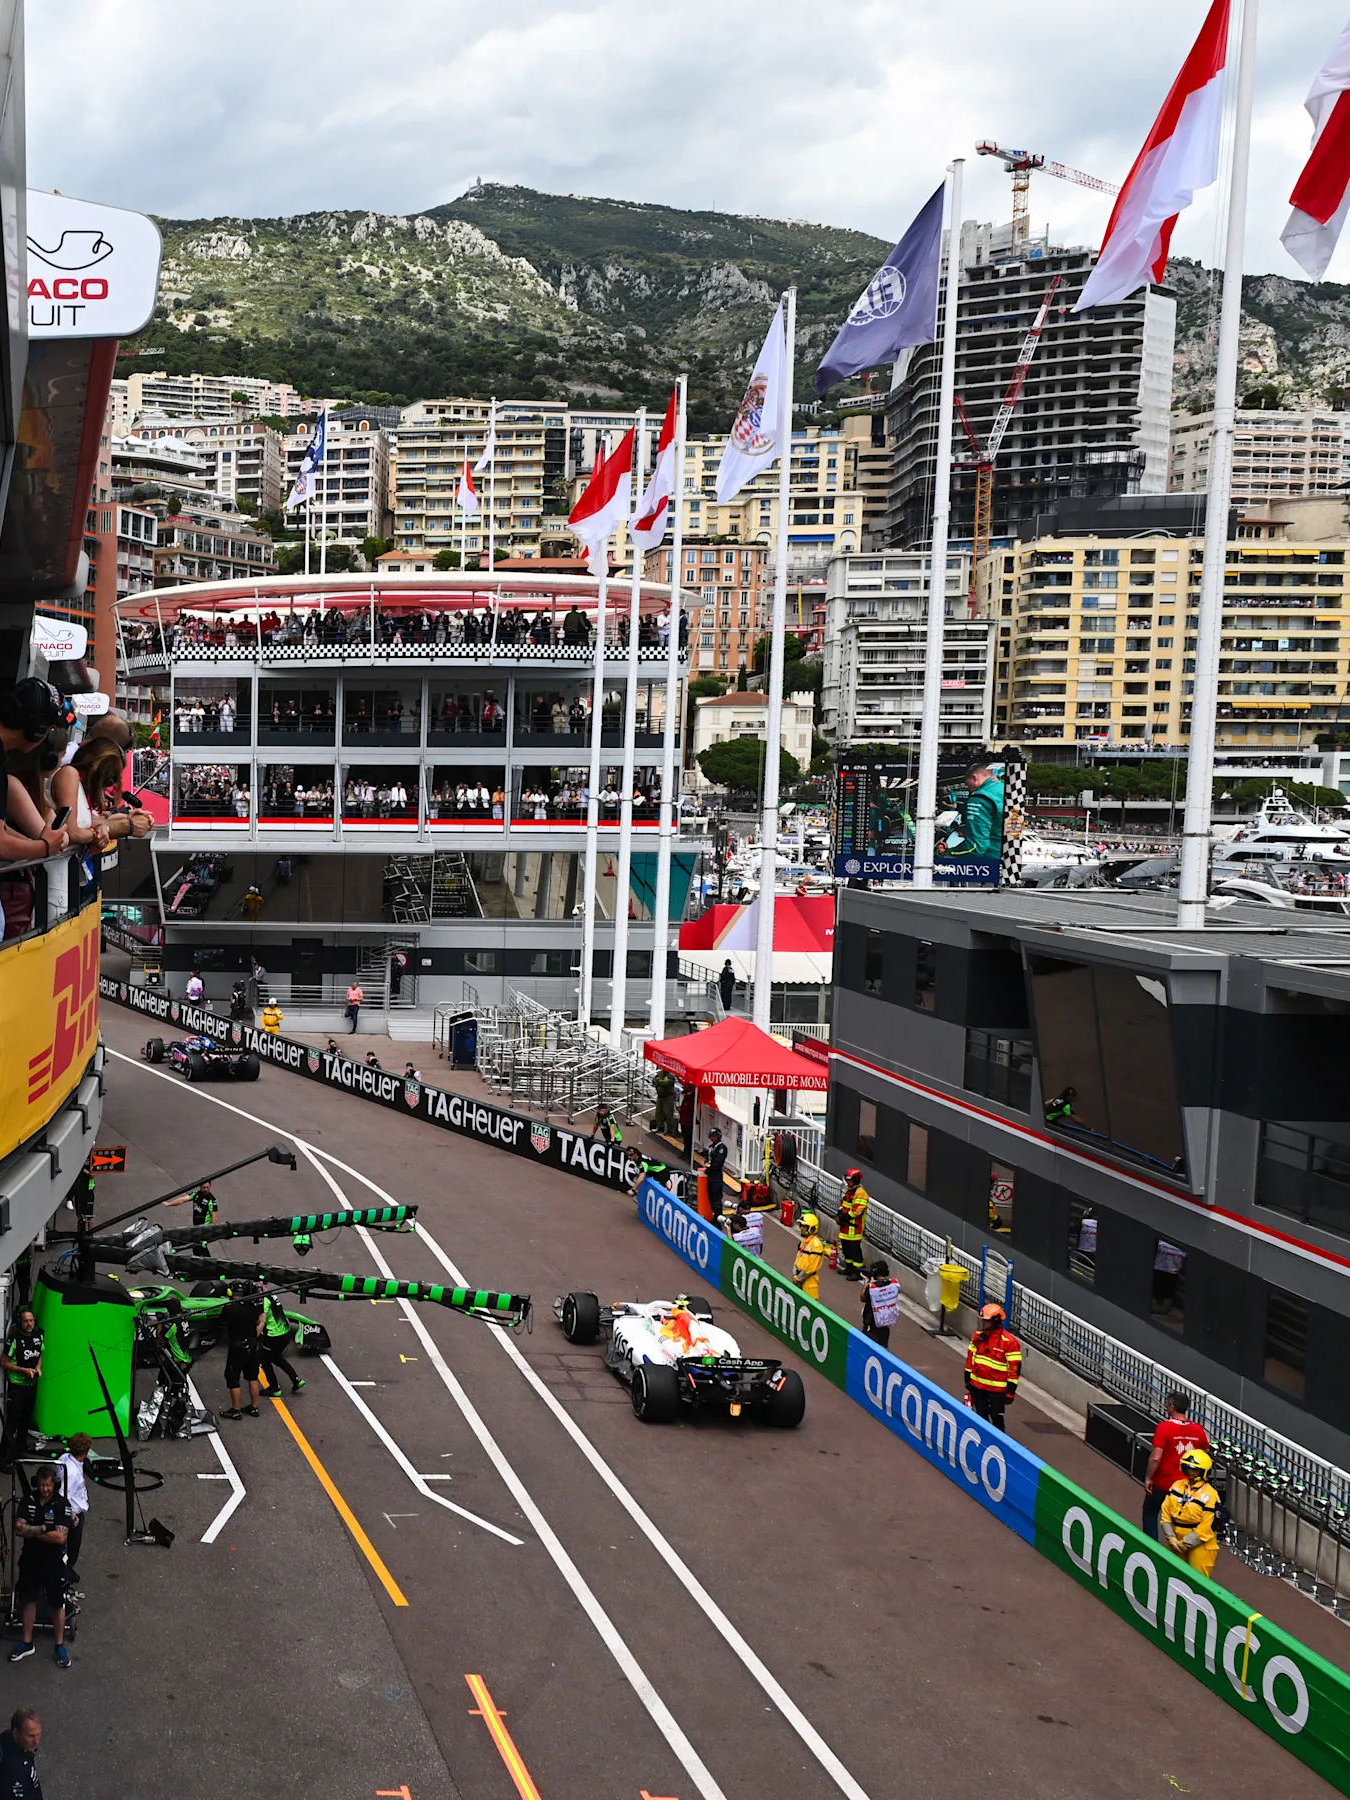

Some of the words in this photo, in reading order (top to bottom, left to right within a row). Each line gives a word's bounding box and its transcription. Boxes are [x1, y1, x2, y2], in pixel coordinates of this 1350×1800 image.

[128, 985, 170, 1024] TAGHeuer
[180, 1004, 230, 1042] TAGHeuer
[244, 1026, 305, 1068] TAGHeuer
[322, 1053, 400, 1102] TAGHeuer
[701, 1071, 760, 1086] AUTOMOBILE
[761, 1073, 785, 1086] CLUB
[786, 1075, 799, 1088] DE
[799, 1076, 827, 1089] MONA
[425, 1087, 524, 1146] TAGHeuer
[645, 1188, 709, 1267] aramco
[732, 1257, 829, 1365] aramco
[613, 1325, 635, 1363] VISA
[718, 1358, 743, 1366] Cash
[743, 1358, 764, 1367] App
[864, 1356, 1007, 1504] aramco
[1061, 1505, 1310, 1735] aramco
